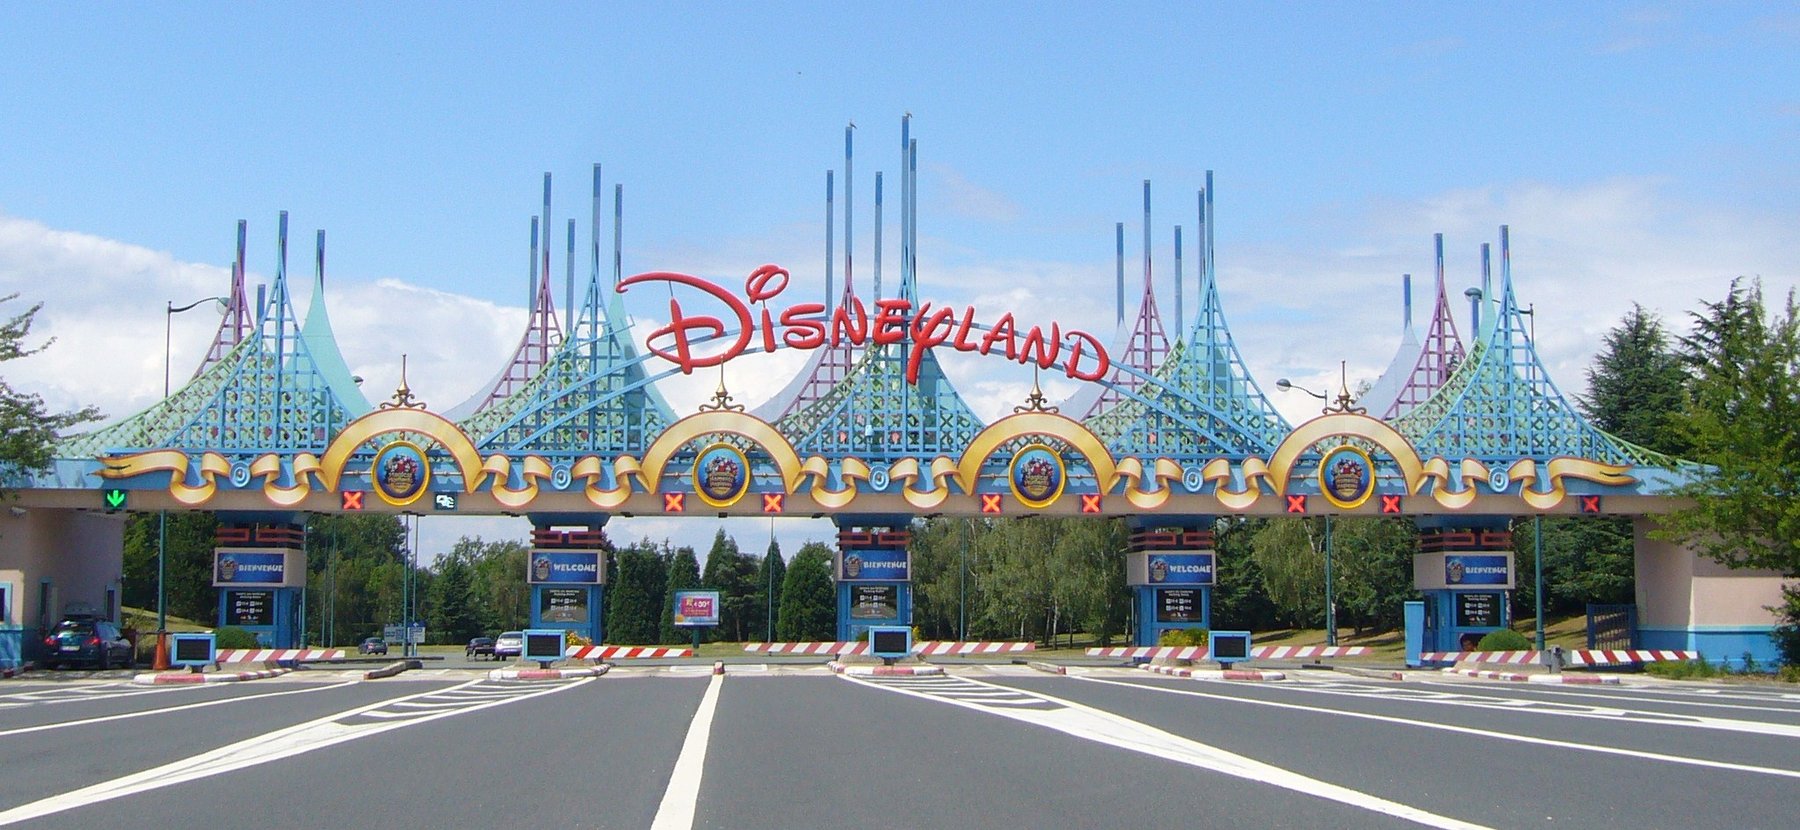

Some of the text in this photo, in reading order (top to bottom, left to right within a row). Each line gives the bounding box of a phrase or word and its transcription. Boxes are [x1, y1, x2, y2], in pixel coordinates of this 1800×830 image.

[239, 564, 283, 572] BIENVENUE
[553, 563, 596, 572] WELCOME
[863, 561, 907, 569] BIENVENUE
[1169, 565, 1212, 573] WELCOME
[1465, 566, 1507, 574] BIENVENUE
